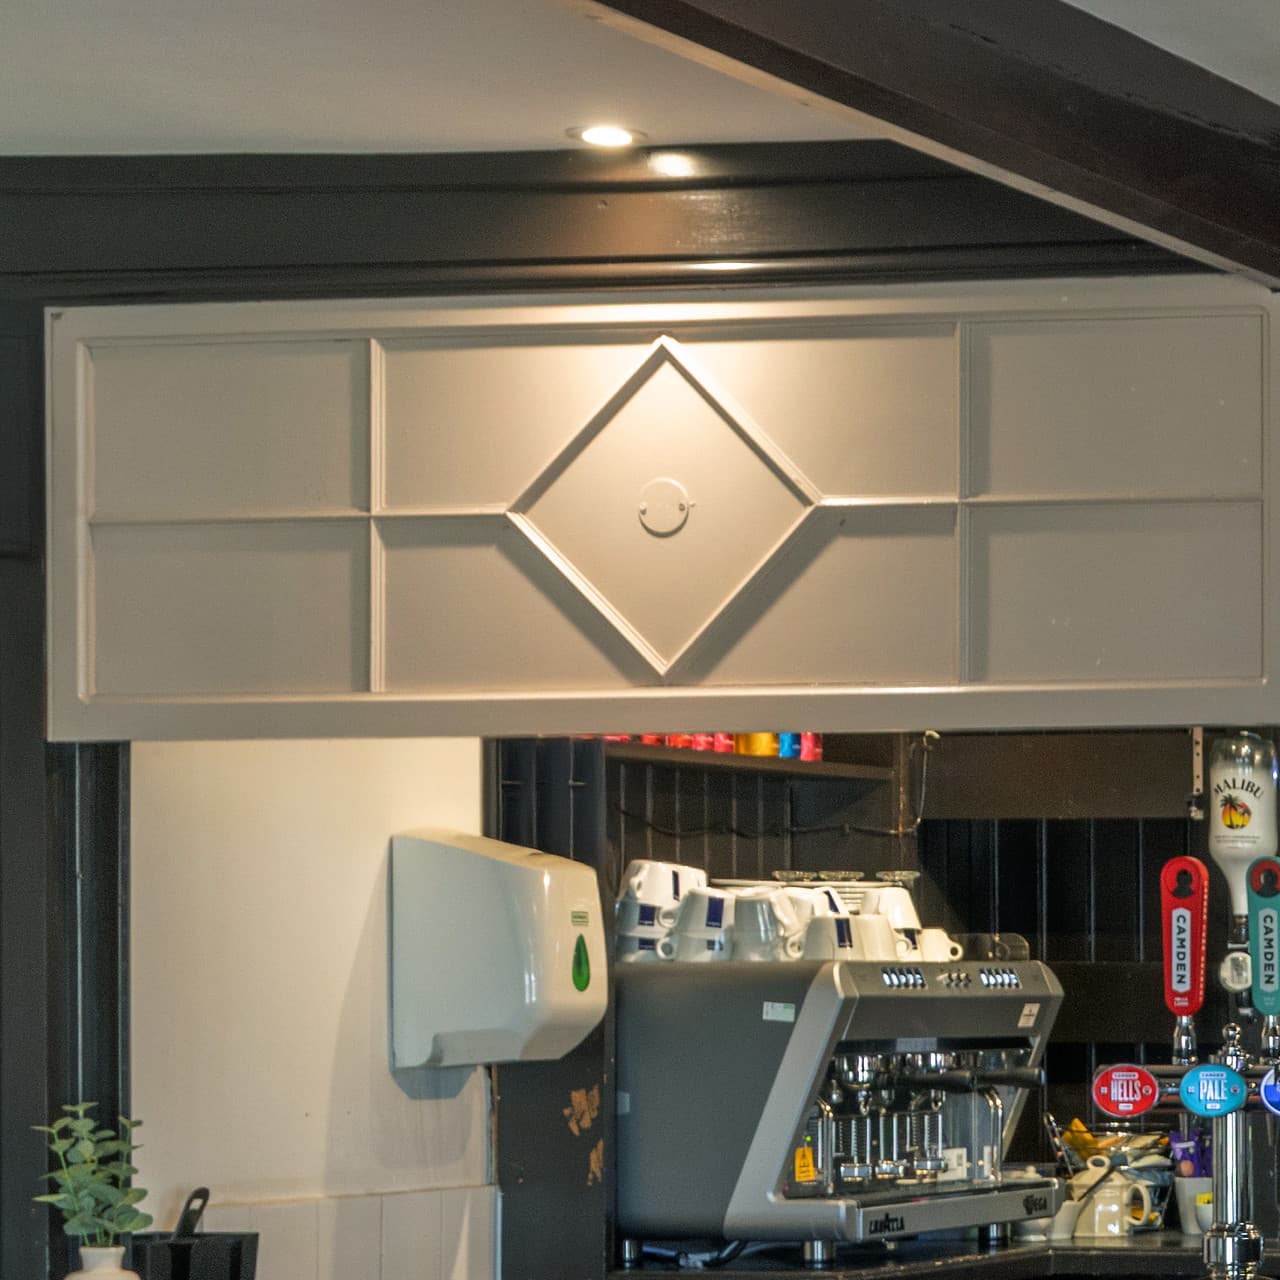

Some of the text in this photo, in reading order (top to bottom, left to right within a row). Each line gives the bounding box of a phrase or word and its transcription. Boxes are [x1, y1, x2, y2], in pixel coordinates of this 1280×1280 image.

[1214, 777, 1264, 799] MALIBU
[1175, 914, 1187, 985] CAMDEN
[1263, 914, 1275, 985] CAMDEN
[1110, 1079, 1142, 1101] HELLS
[1199, 1079, 1228, 1101] PALE
